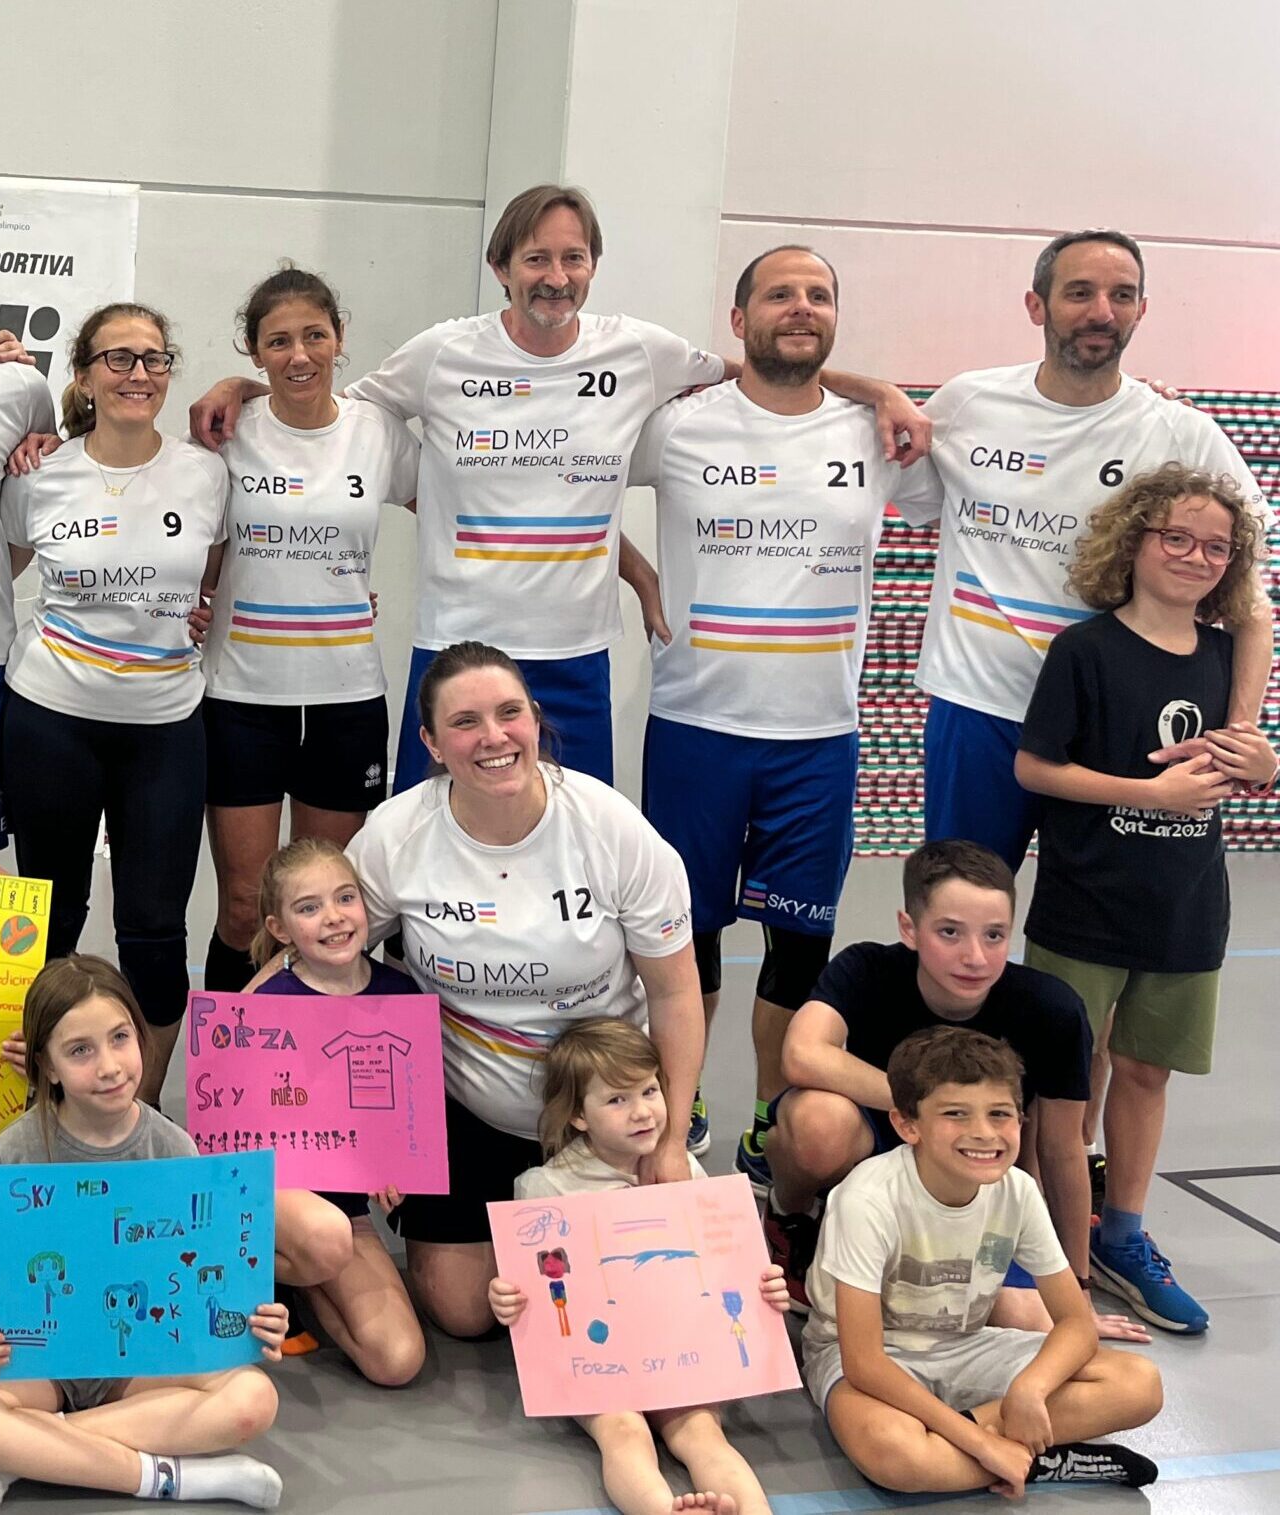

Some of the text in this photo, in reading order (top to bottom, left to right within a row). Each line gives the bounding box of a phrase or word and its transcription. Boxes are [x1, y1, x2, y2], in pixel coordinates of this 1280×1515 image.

[576, 370, 617, 398] 20
[516, 428, 569, 450] MXP
[456, 454, 622, 468] AIRPORT MEDICAL SERVICES
[826, 460, 866, 488] 21
[1098, 460, 1124, 488] 6
[346, 474, 364, 498] 3
[162, 512, 182, 538] 9
[760, 518, 817, 540] MXP
[1016, 508, 1078, 536] MXP
[290, 526, 340, 545] MXP
[958, 524, 1070, 556] AIRPORT MEDICAL
[238, 546, 334, 561] AIRPORT MEDICAL
[698, 544, 865, 558] AIRPORT MEDICAL SERVICE
[103, 566, 156, 587] MXP
[102, 591, 195, 604] MEDICAL SERVIC
[552, 888, 593, 922] 12
[767, 894, 808, 916] SKY
[484, 962, 549, 985] MXP
[423, 974, 478, 997] AIRPORT
[484, 986, 548, 998] MEDICAL
[190, 996, 298, 1057] FORZA
[270, 1086, 308, 1106] MED
[8, 1178, 110, 1212] SKY MED
[168, 1272, 182, 1344] SKY
[572, 1356, 630, 1378] FORZA
